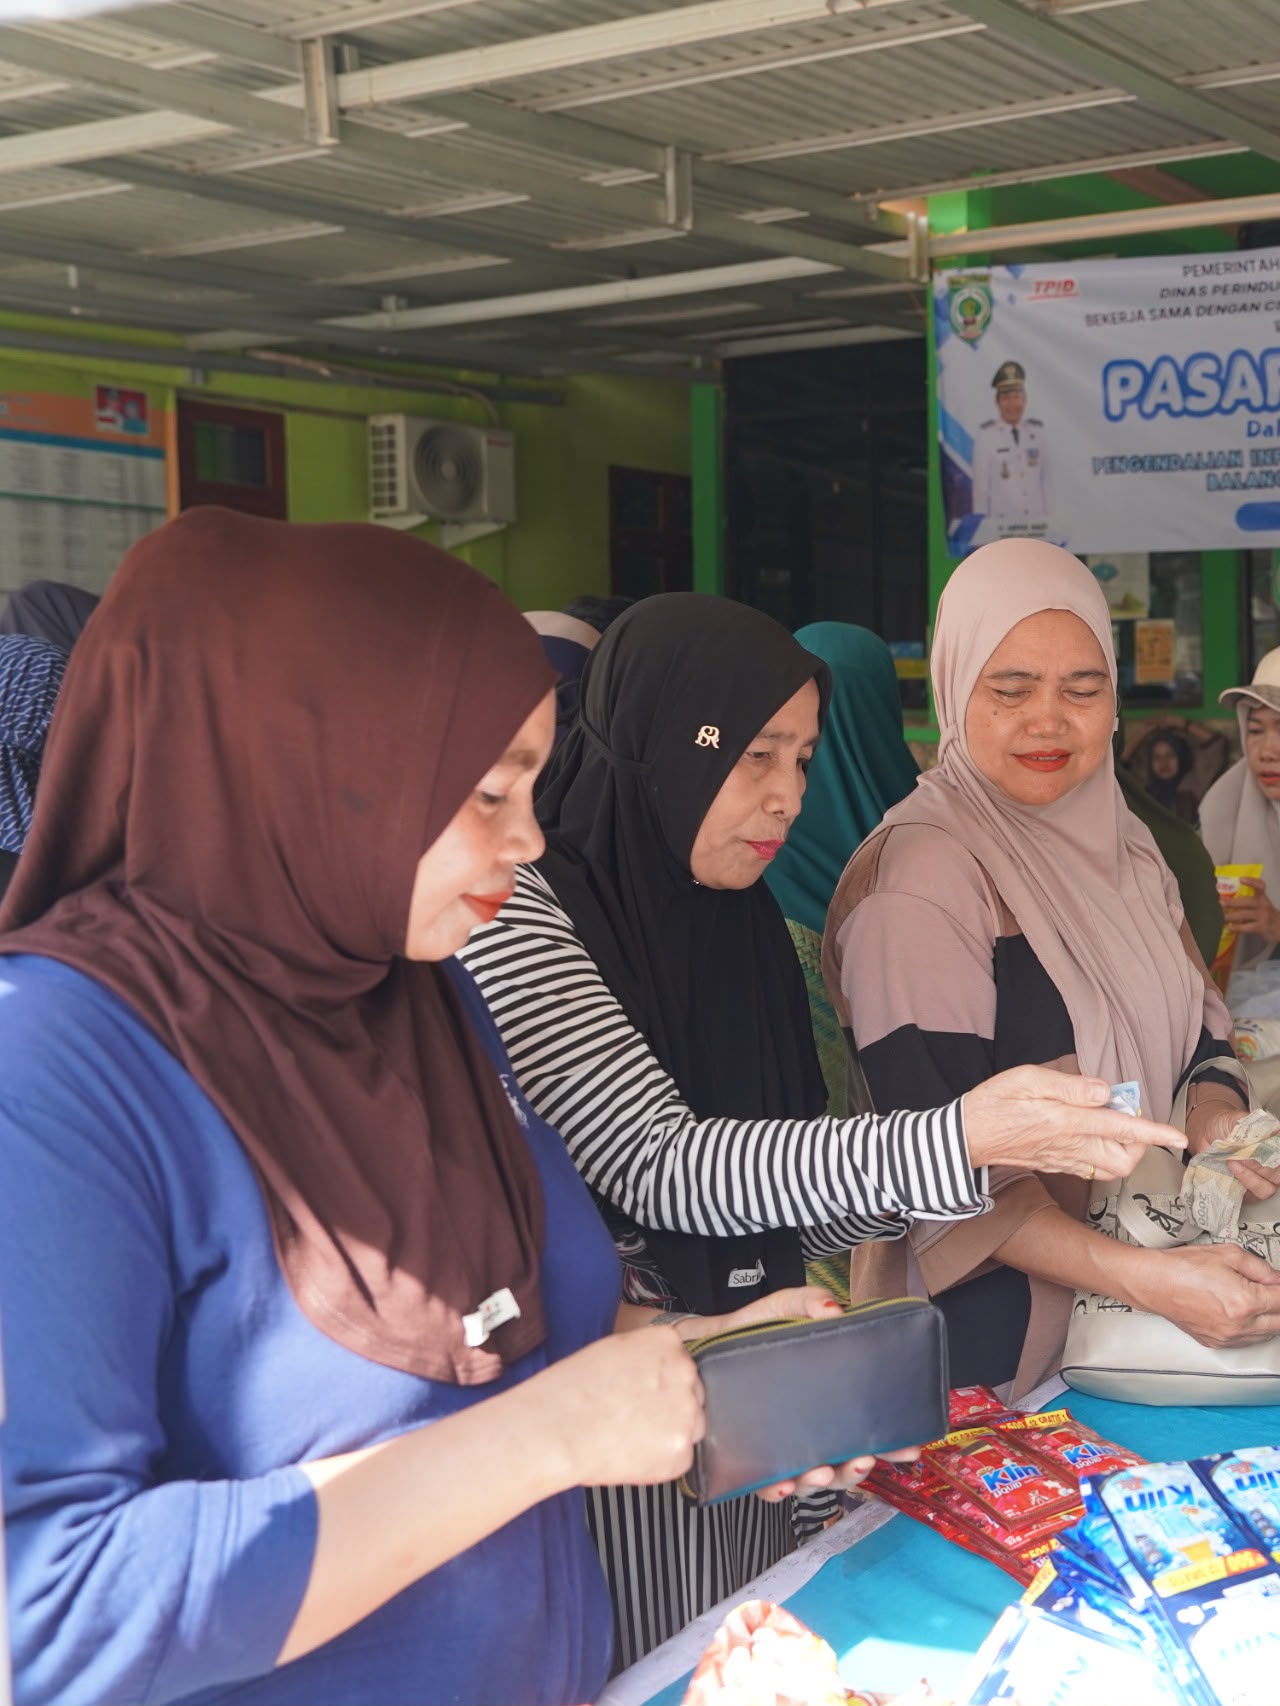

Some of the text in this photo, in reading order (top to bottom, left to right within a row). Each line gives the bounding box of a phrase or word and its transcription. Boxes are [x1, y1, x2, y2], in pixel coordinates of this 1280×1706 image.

[1182, 254, 1280, 278] PEMERINTAH
[1159, 284, 1207, 300] DINAS
[1085, 308, 1146, 327] BEKERJA
[1149, 304, 1192, 321] SAMA
[1195, 299, 1261, 318] DENGAN
[1092, 449, 1244, 475] PENGENDALIAN
[1038, 1414, 1062, 1426] GRATIS
[1063, 1440, 1120, 1465] Klin
[1074, 1455, 1102, 1469] LIQUID
[982, 1461, 1043, 1493] Klin
[994, 1481, 1022, 1499] LIQUID
[1124, 1483, 1195, 1512] Klin
